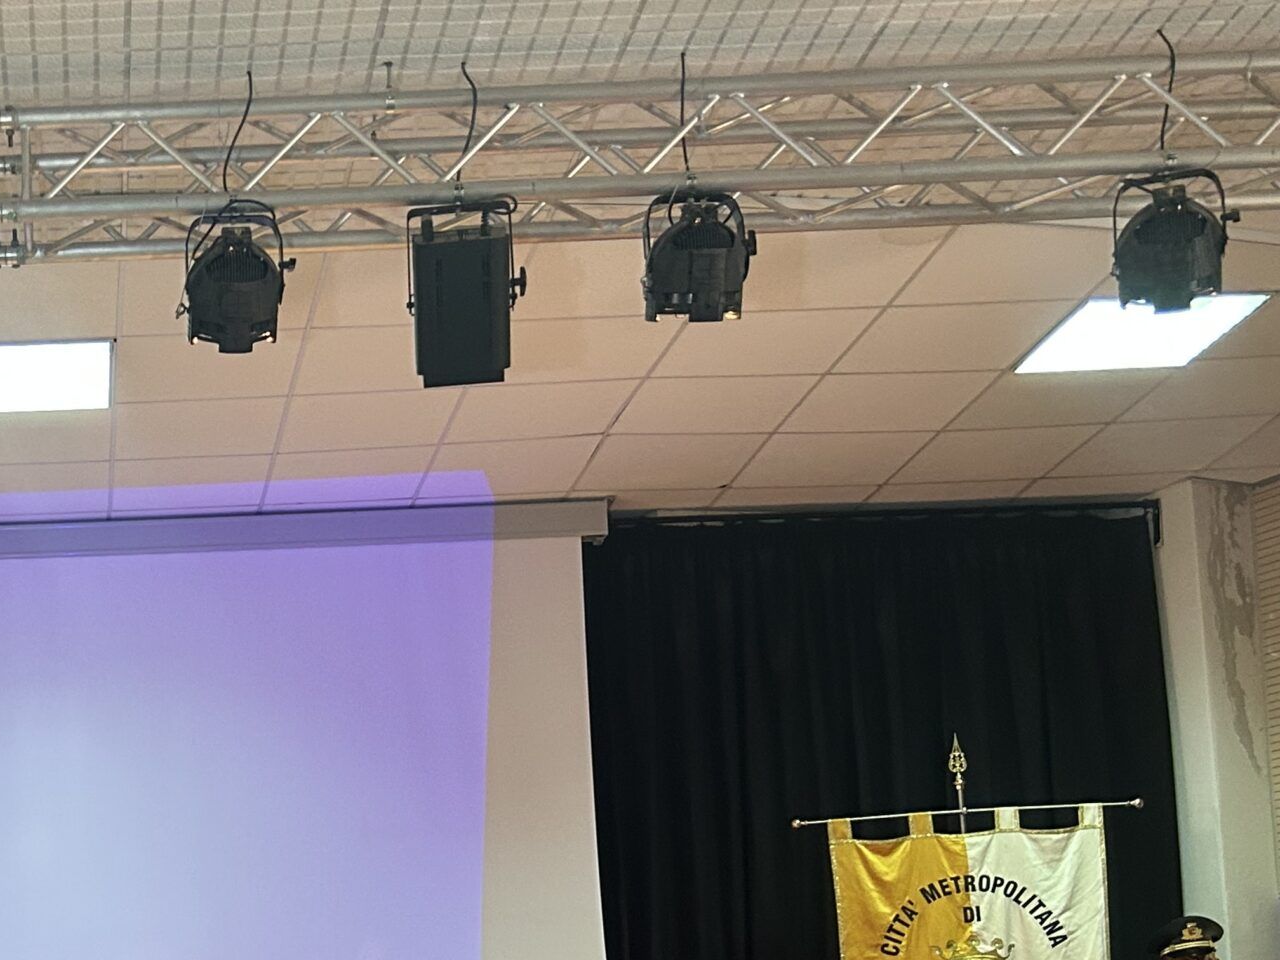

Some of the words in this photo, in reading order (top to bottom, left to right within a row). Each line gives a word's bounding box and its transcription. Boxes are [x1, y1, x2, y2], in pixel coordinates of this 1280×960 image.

[880, 900, 919, 956] CITTA'
[919, 874, 1069, 949] METROPOLITANA
[962, 905, 981, 923] DI
